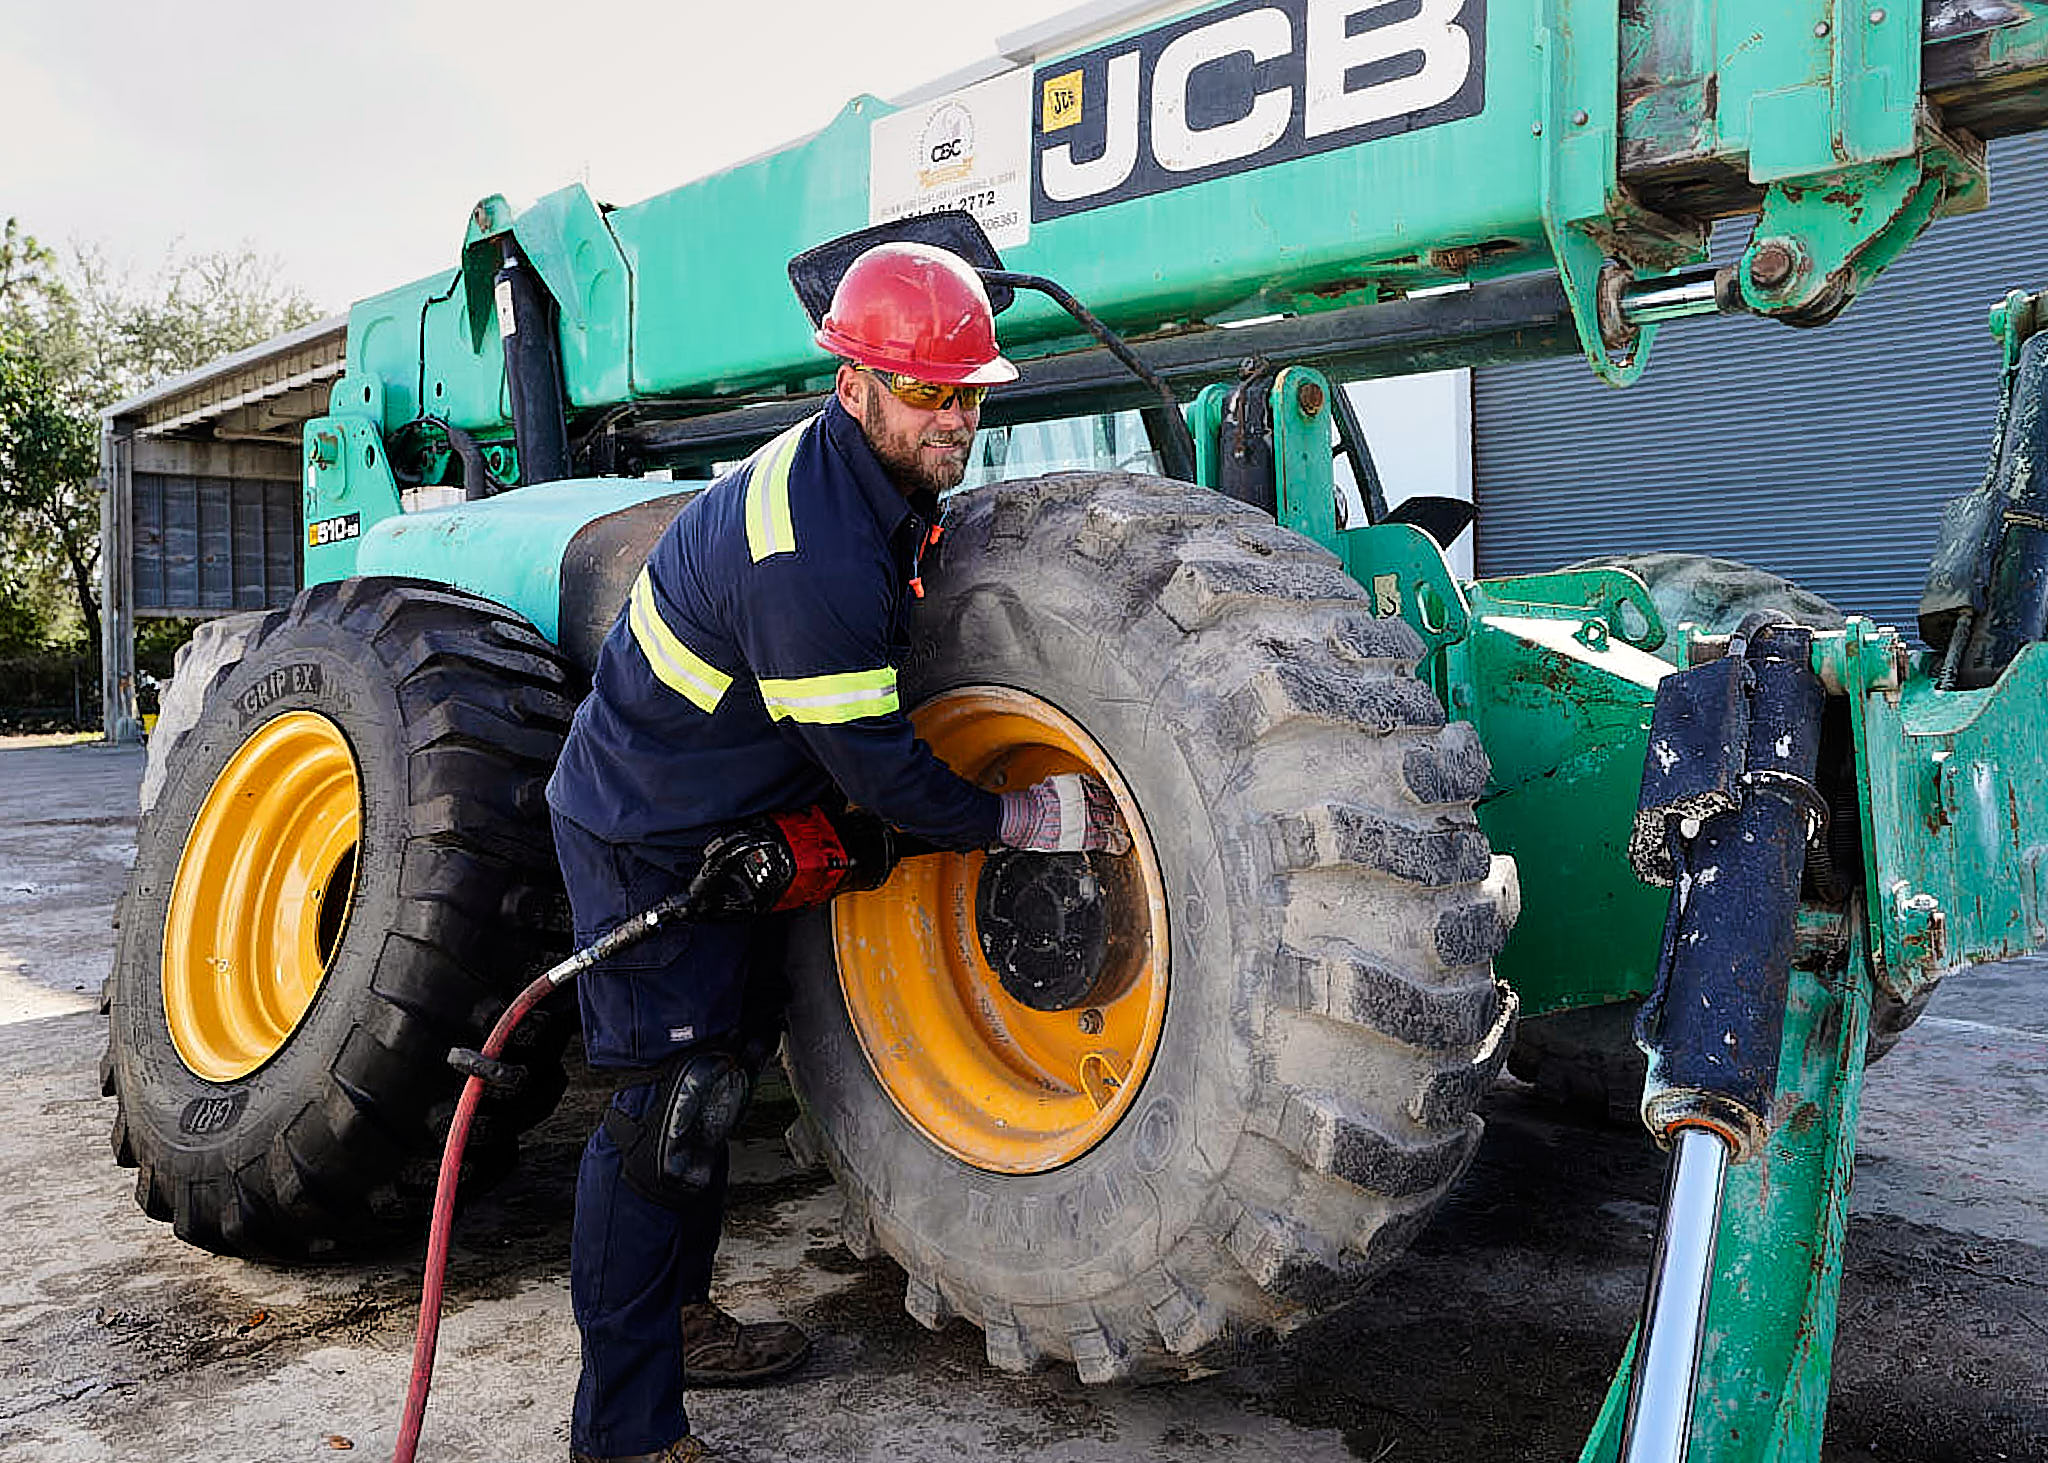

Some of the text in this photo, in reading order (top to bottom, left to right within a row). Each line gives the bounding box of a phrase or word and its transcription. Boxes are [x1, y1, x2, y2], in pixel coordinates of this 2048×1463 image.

[1041, 0, 1470, 202] JCB
[244, 669, 286, 715] GRIP
[292, 664, 315, 693] EX
